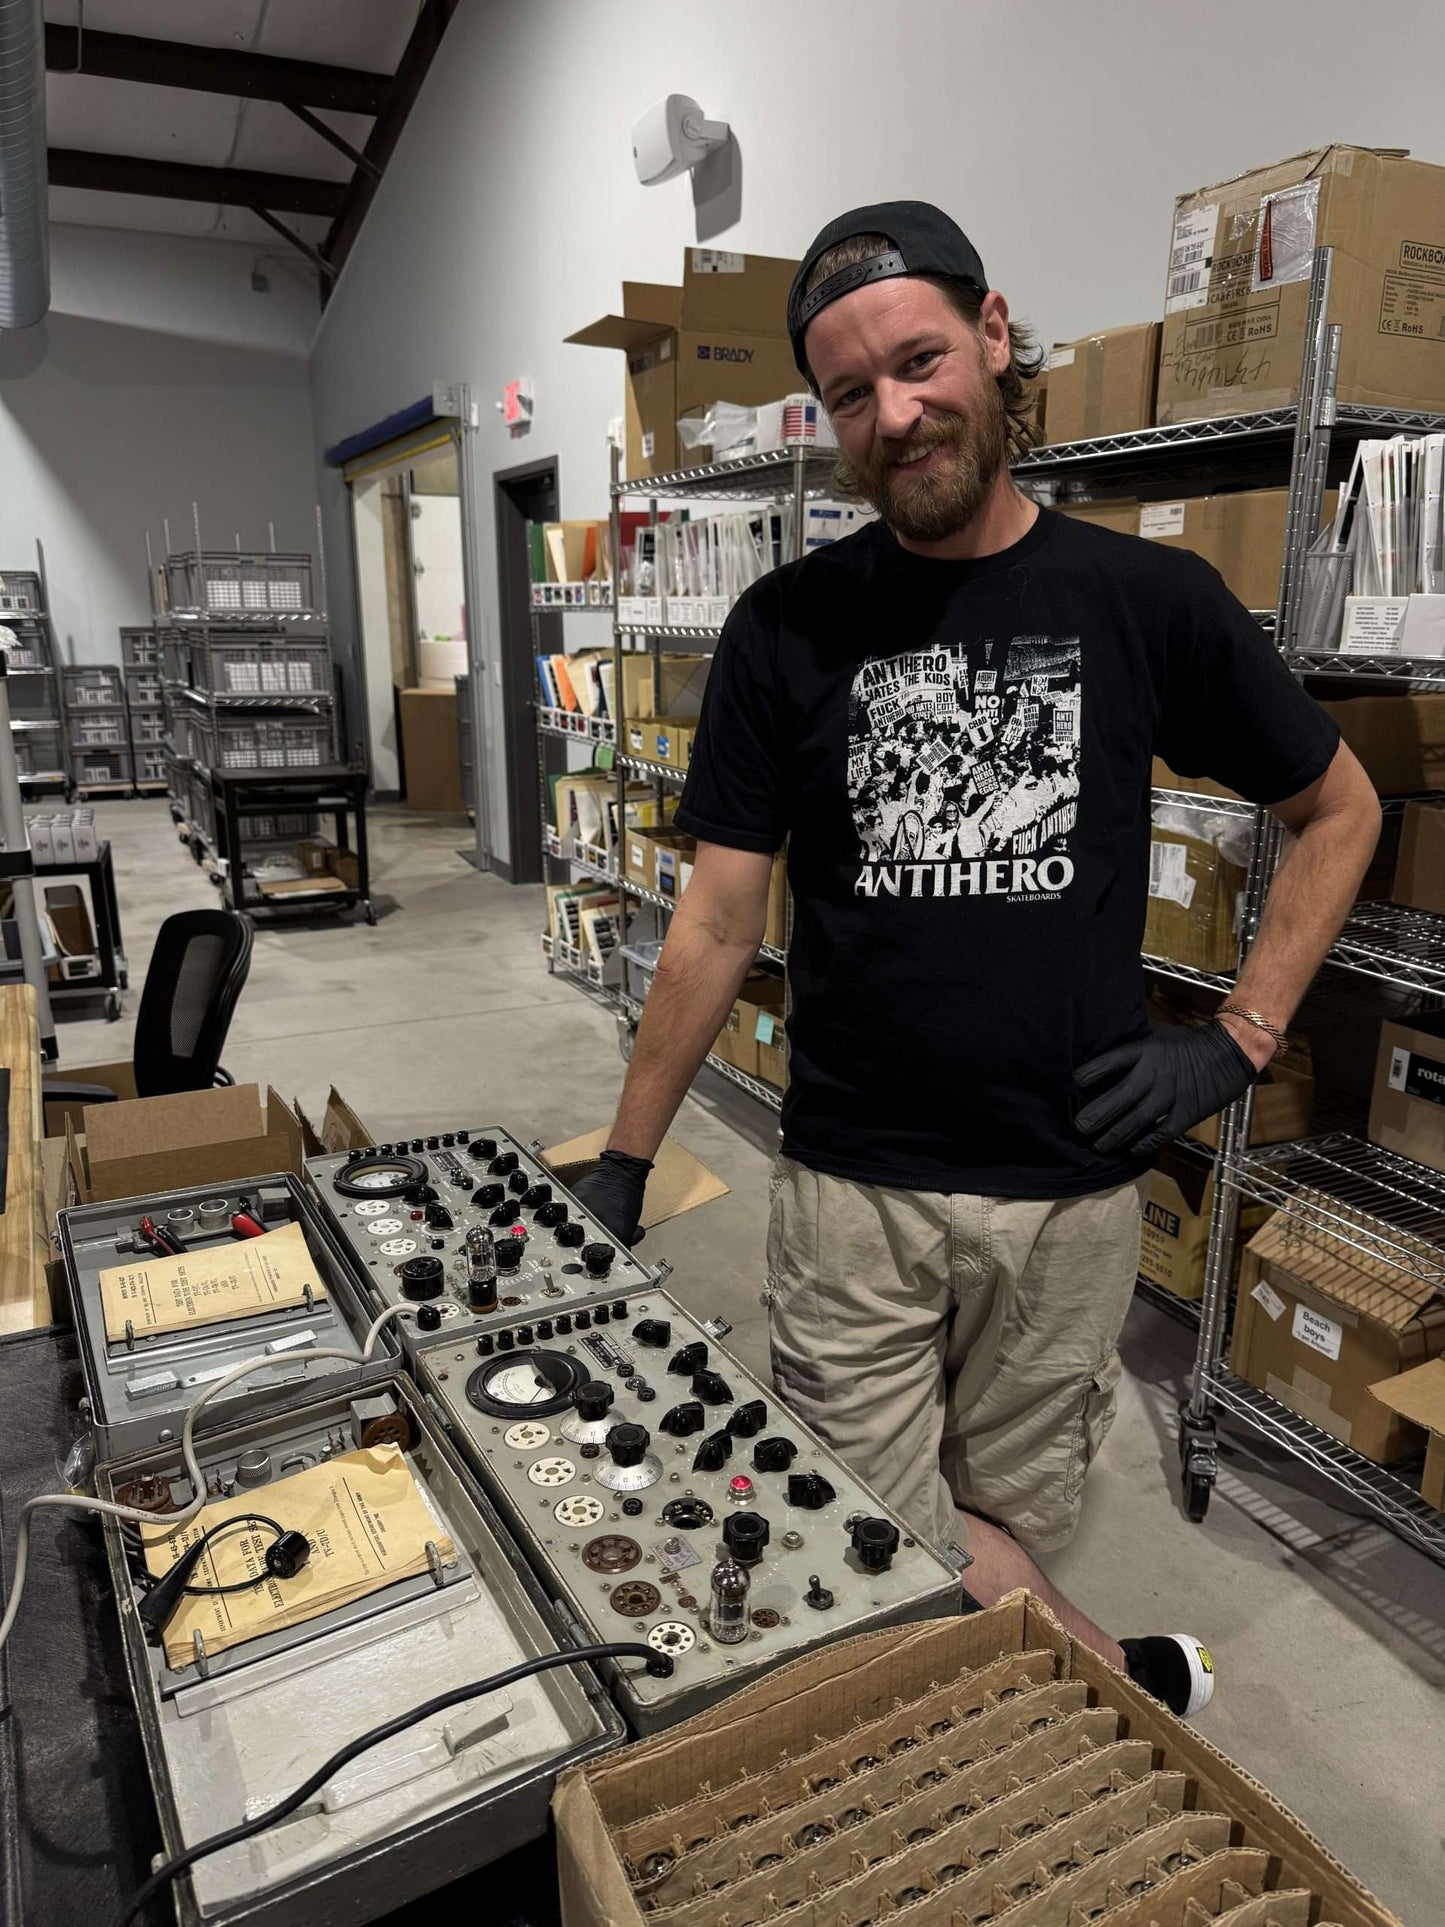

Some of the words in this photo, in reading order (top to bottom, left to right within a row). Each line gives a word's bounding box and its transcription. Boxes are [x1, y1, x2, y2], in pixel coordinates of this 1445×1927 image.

[1404, 245, 1445, 264] ROCKBO
[1248, 324, 1272, 336] RoHS
[1402, 323, 1423, 334] RoHS
[713, 346, 754, 363] BRADY
[863, 654, 947, 688] ANTIHERO
[865, 680, 900, 701] HATES
[904, 673, 920, 687] THE
[924, 673, 950, 686] KIDS
[936, 692, 954, 702] BOY
[975, 695, 1000, 709] NO
[870, 699, 901, 720] FUCK
[968, 716, 988, 730] CHAD
[852, 756, 865, 768] MY
[972, 761, 992, 775] ANTI
[851, 766, 870, 779] LIFE
[974, 769, 994, 782] HERO
[977, 776, 997, 789] SUCKS
[979, 781, 999, 795] EGGS
[1013, 824, 1037, 855] FUCK
[854, 856, 1074, 897] ANTIHERO
[1006, 892, 1061, 903] SKATEBOARDS
[1417, 1068, 1445, 1086] rota
[1142, 1202, 1176, 1233] INE
[1302, 1311, 1331, 1333] Beach
[1304, 1324, 1326, 1342] boys
[240, 1539, 251, 1556] FOR
[252, 1534, 264, 1553] TEST
[309, 1538, 320, 1554] AND
[316, 1529, 335, 1558] TV-7D/U
[245, 1557, 259, 1578] DATA
